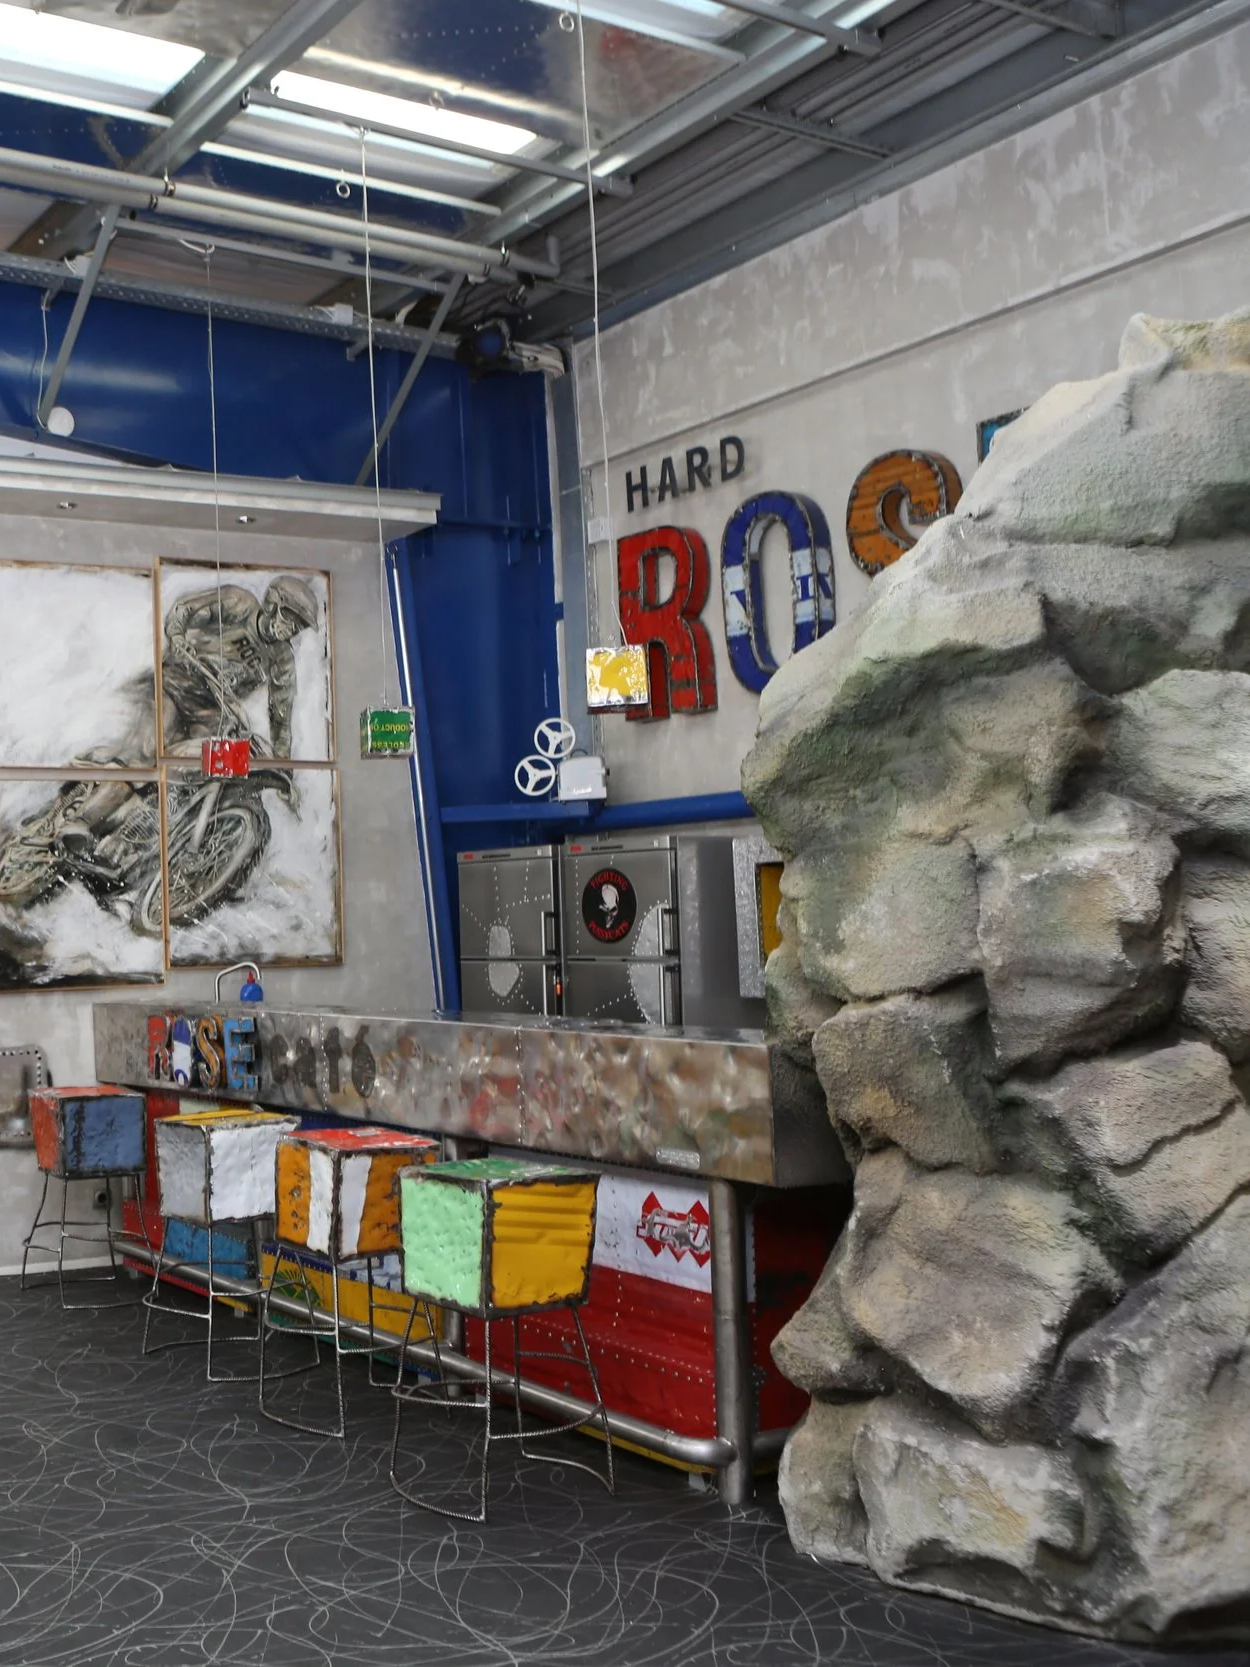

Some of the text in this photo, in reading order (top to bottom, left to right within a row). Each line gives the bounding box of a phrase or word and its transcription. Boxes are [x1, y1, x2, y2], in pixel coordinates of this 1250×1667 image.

[625, 435, 746, 513] HARD
[589, 871, 629, 891] FIGHTING
[147, 1010, 260, 1092] ROSE
